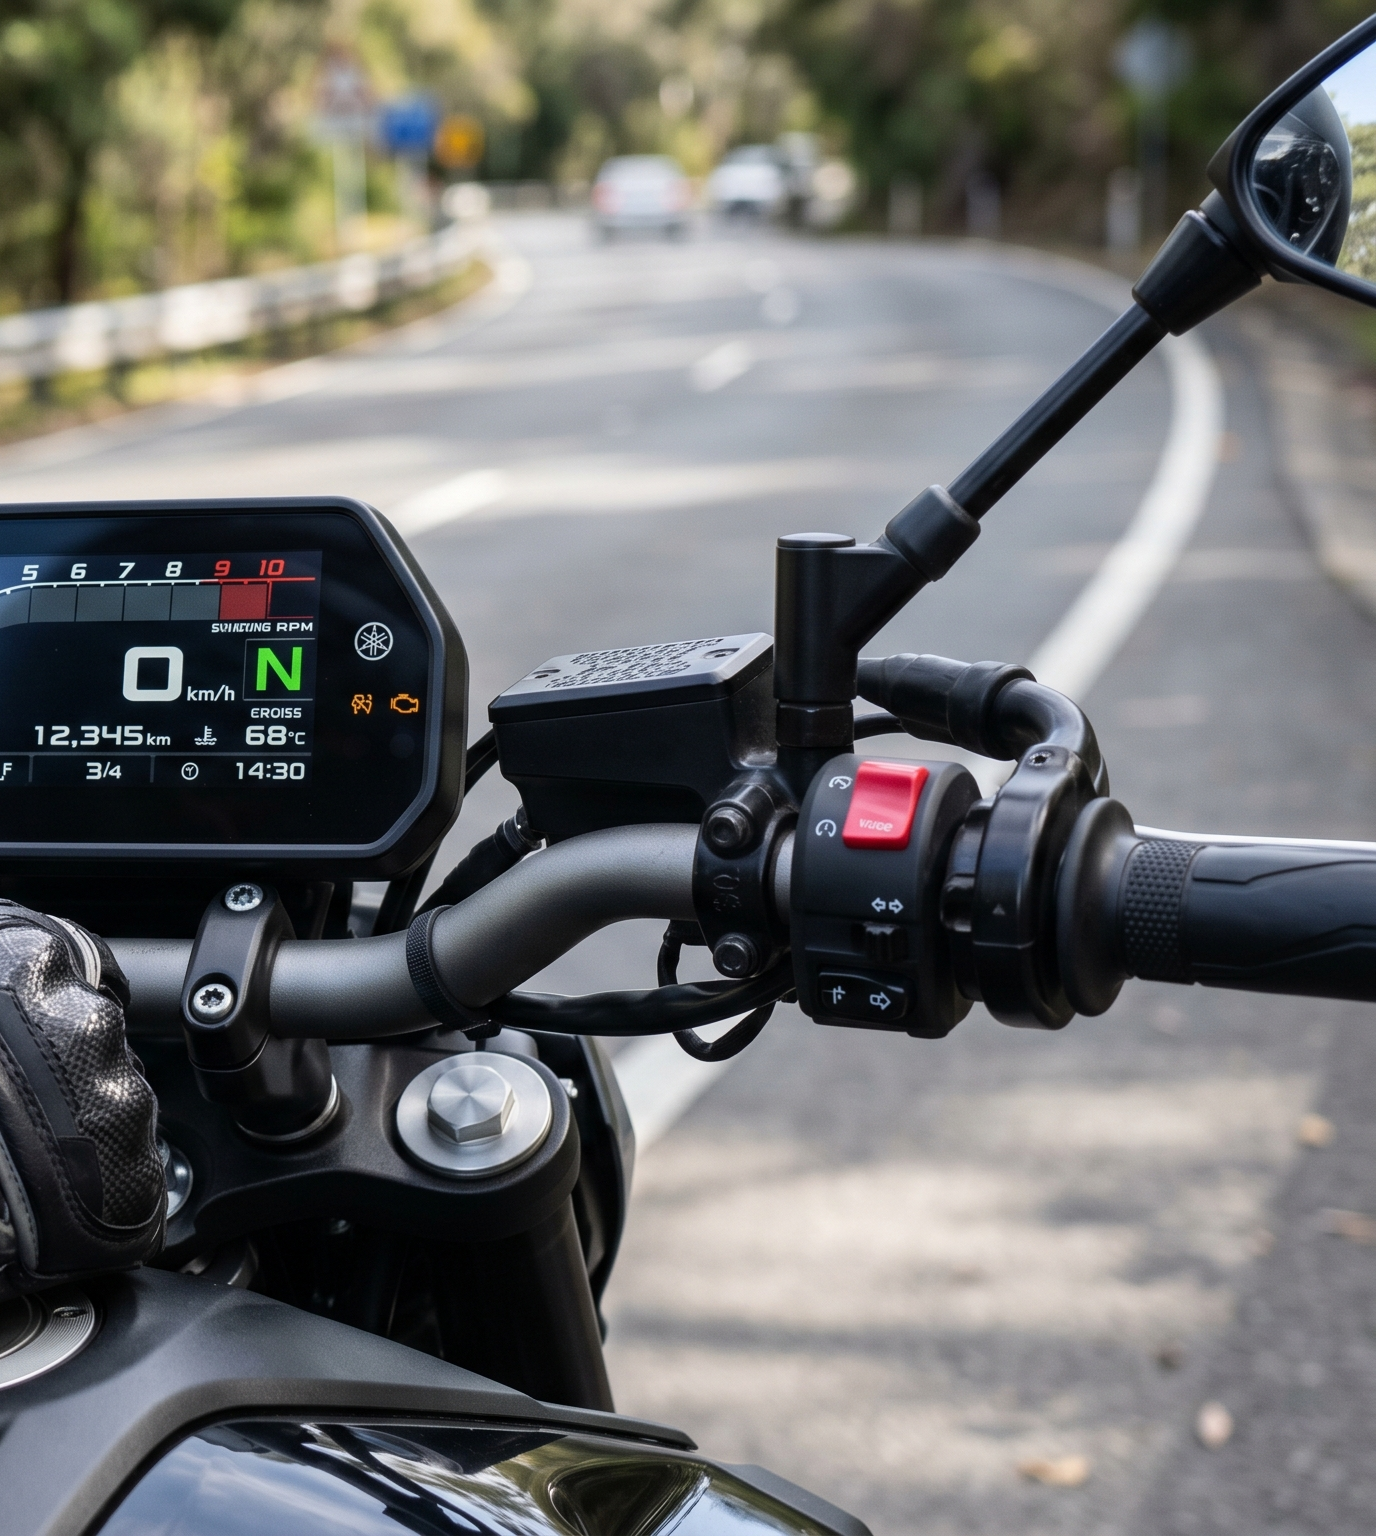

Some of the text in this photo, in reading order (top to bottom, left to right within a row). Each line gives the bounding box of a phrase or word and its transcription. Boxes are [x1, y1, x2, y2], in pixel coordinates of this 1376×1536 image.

[21, 564, 40, 581] 5
[70, 563, 88, 580] 6
[118, 562, 136, 579] 7
[165, 561, 183, 578] 8
[213, 560, 231, 577] 9
[259, 559, 285, 576] 10
[276, 622, 314, 632] RPM
[122, 646, 235, 702] 0 km/h
[255, 646, 303, 691] N
[34, 725, 144, 748] 12,345
[146, 732, 171, 746] km
[2, 762, 13, 776] F
[85, 761, 122, 780] 3/4
[236, 762, 306, 780] 14:30
